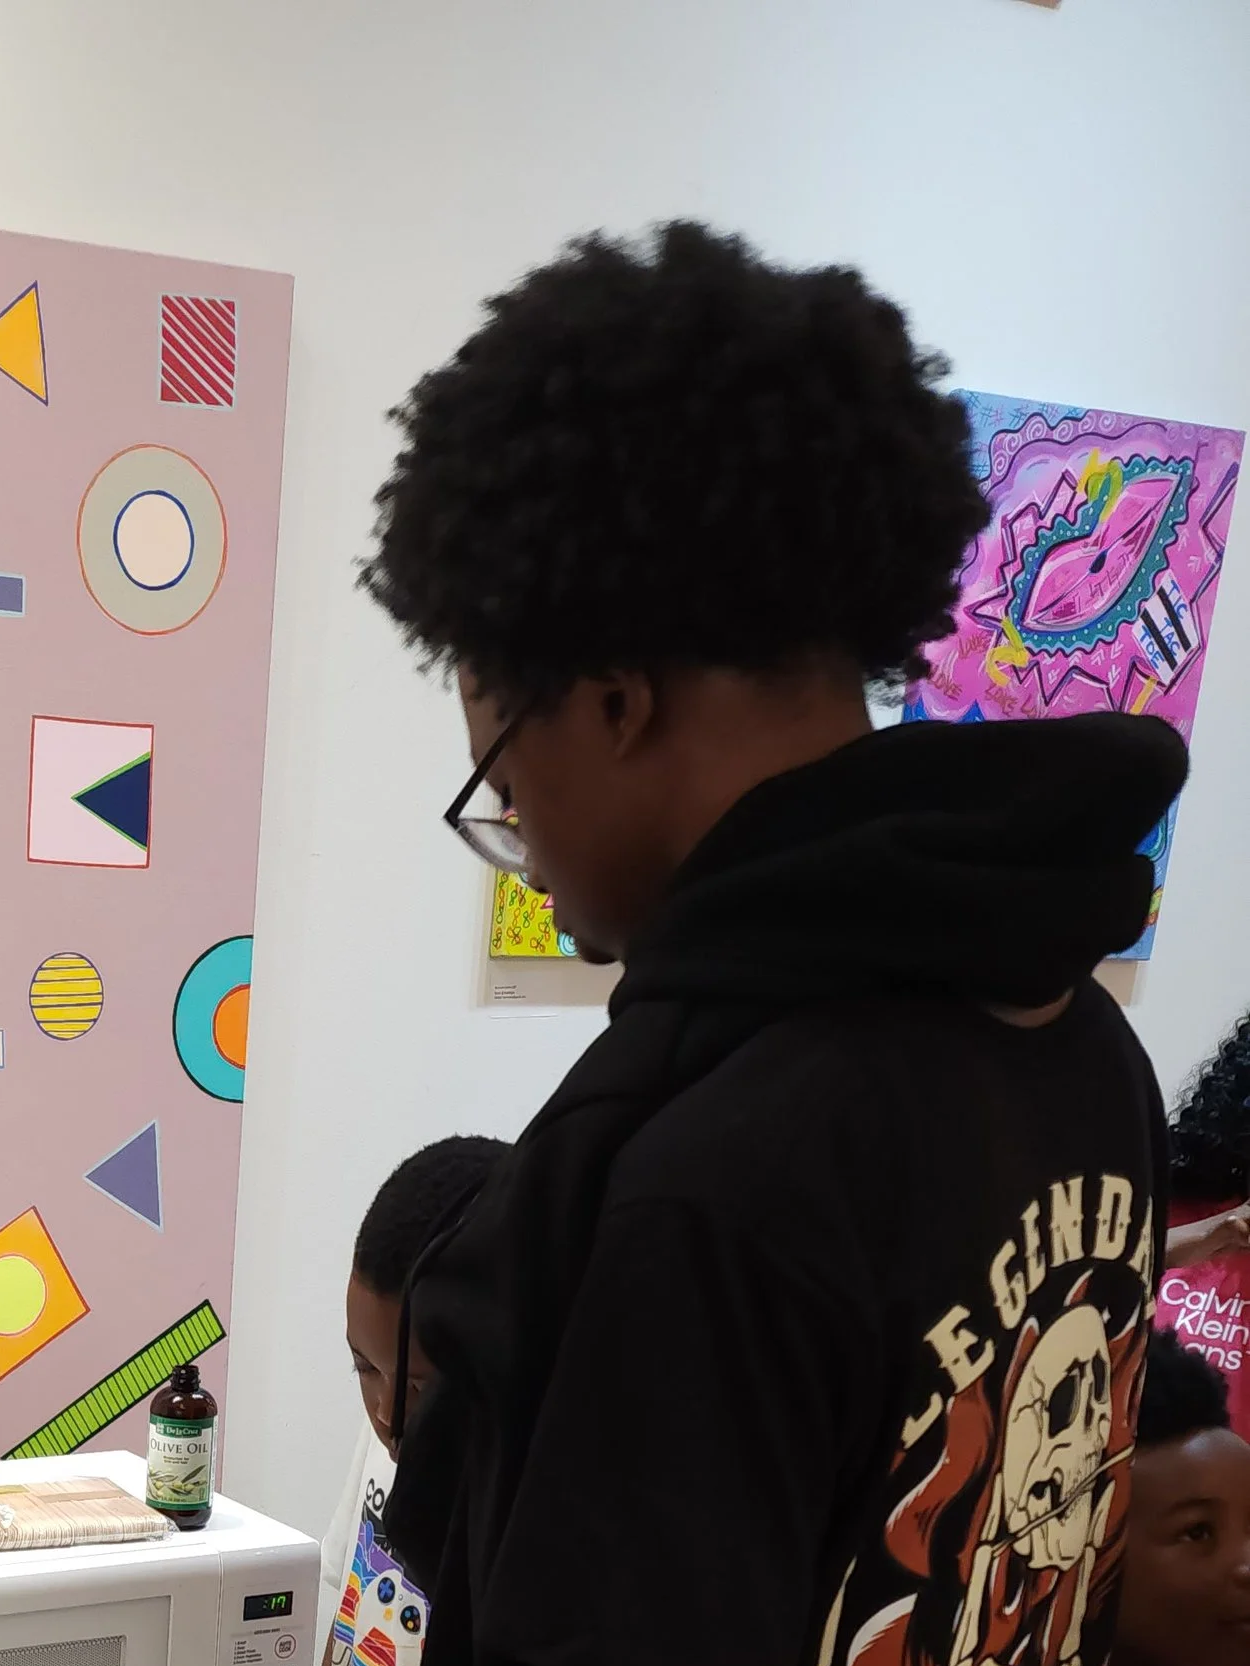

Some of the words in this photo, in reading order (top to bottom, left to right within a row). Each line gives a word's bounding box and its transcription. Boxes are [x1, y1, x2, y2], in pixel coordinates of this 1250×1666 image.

[1167, 579, 1188, 620] TIC
[1140, 624, 1165, 670] TOE
[1160, 617, 1181, 657] TAC
[1174, 1307, 1250, 1345] Klein
[150, 1438, 183, 1454] OLIVE
[187, 1442, 209, 1455] OIL
